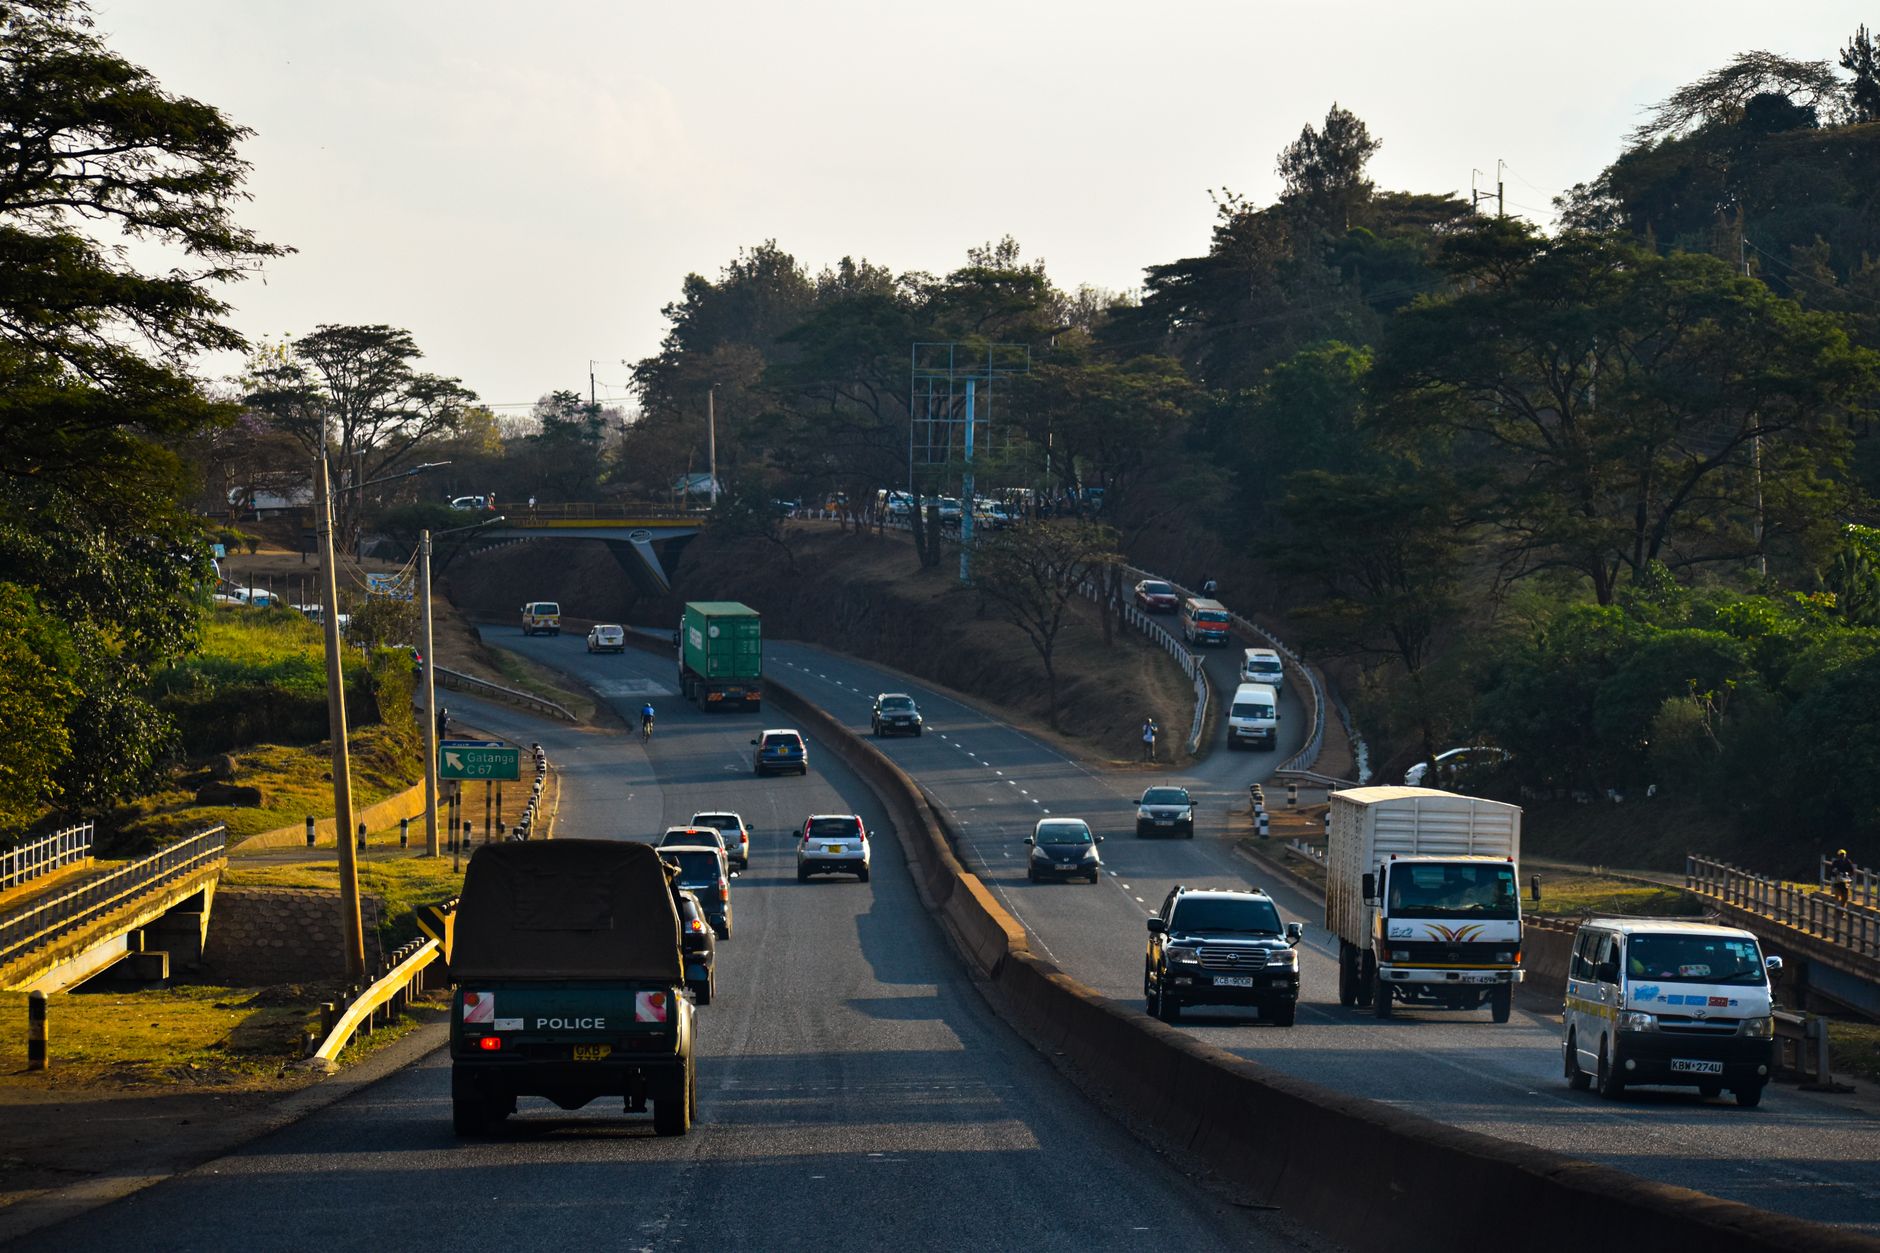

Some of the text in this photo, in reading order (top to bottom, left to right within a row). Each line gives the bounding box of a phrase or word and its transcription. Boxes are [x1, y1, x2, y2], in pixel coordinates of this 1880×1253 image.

[466, 765, 492, 774] C 67
[536, 1018, 606, 1029] POLICE
